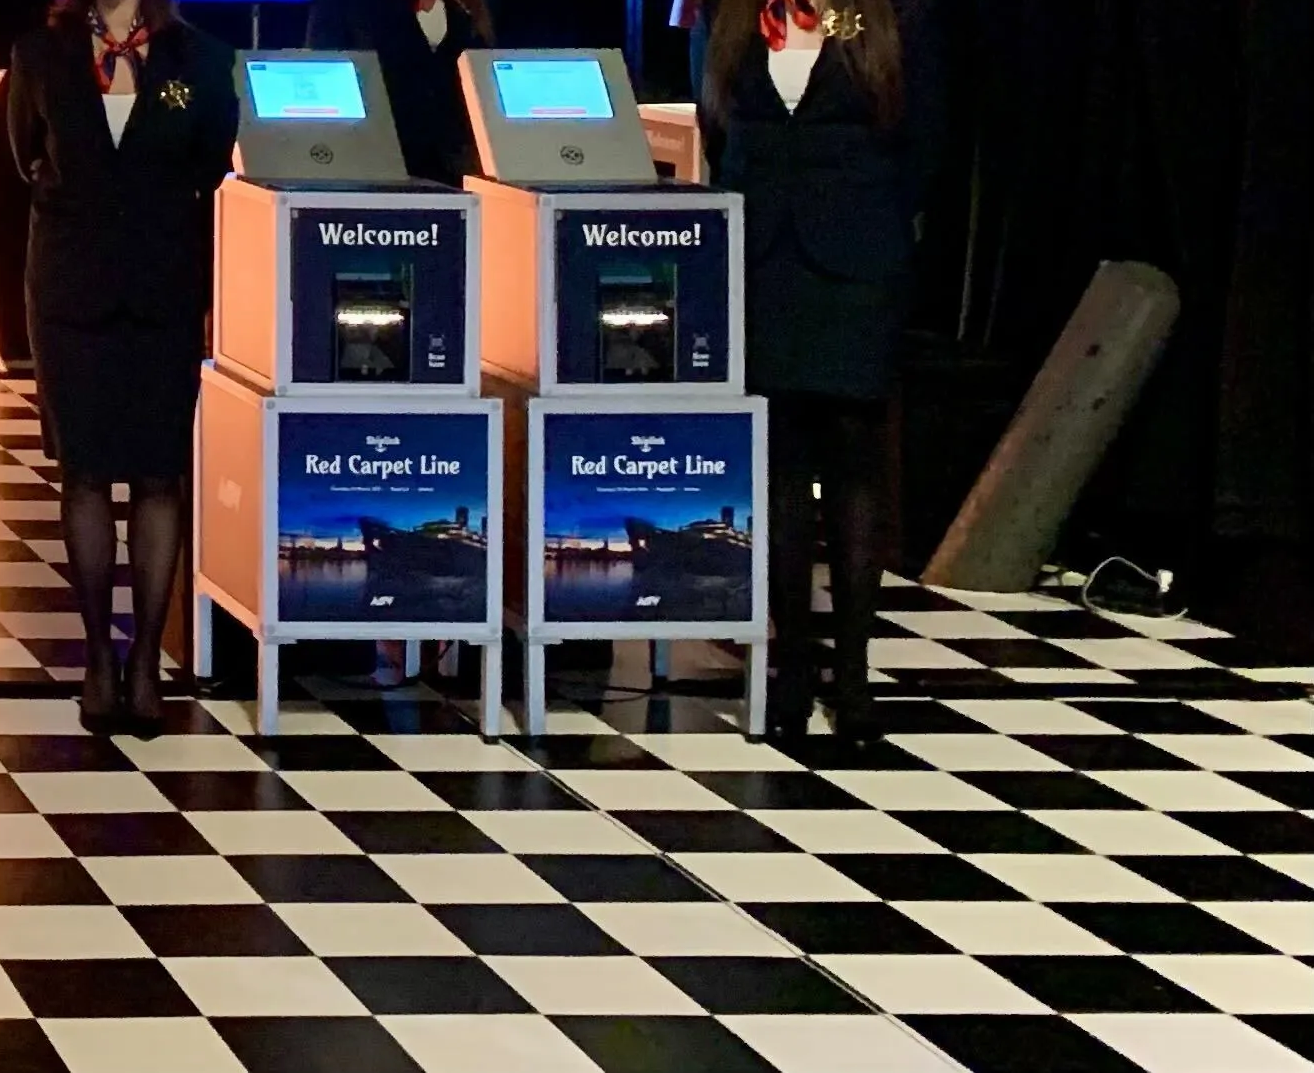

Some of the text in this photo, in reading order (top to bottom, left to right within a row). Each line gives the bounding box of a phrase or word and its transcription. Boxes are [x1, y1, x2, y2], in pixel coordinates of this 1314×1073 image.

[318, 222, 438, 246] Welcome!
[581, 222, 701, 247] Welcome!
[305, 454, 460, 480] Red Carpet Line
[572, 454, 726, 480] Red Carpet Line
